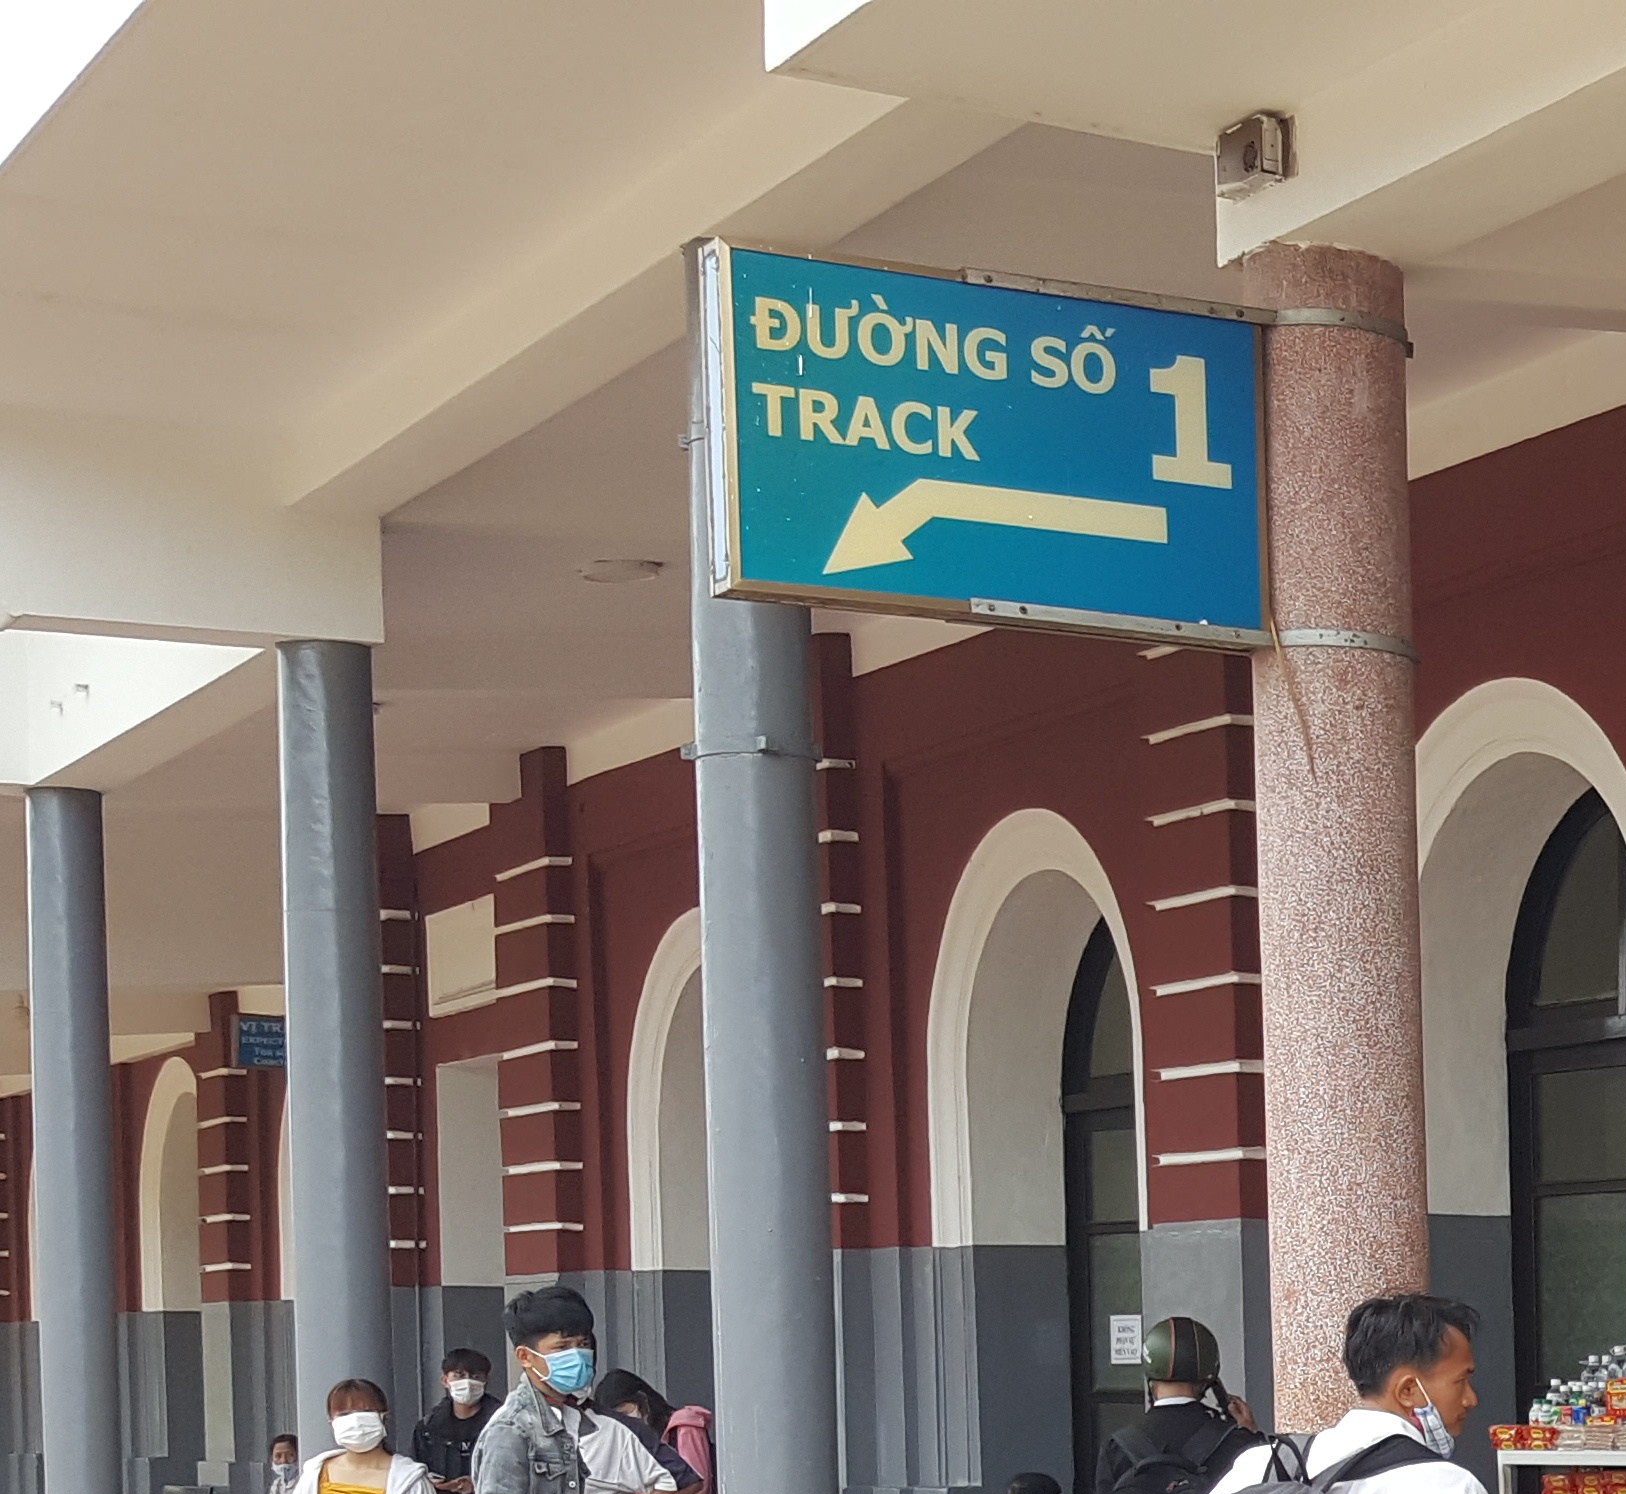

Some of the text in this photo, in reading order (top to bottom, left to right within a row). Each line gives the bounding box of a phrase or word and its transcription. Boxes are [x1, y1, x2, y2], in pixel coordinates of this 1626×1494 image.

[750, 295, 1118, 396] ĐƯỜNG SỐ
[752, 381, 981, 462] TRACK
[1149, 354, 1232, 490] 1
[261, 1022, 284, 1033] TR
